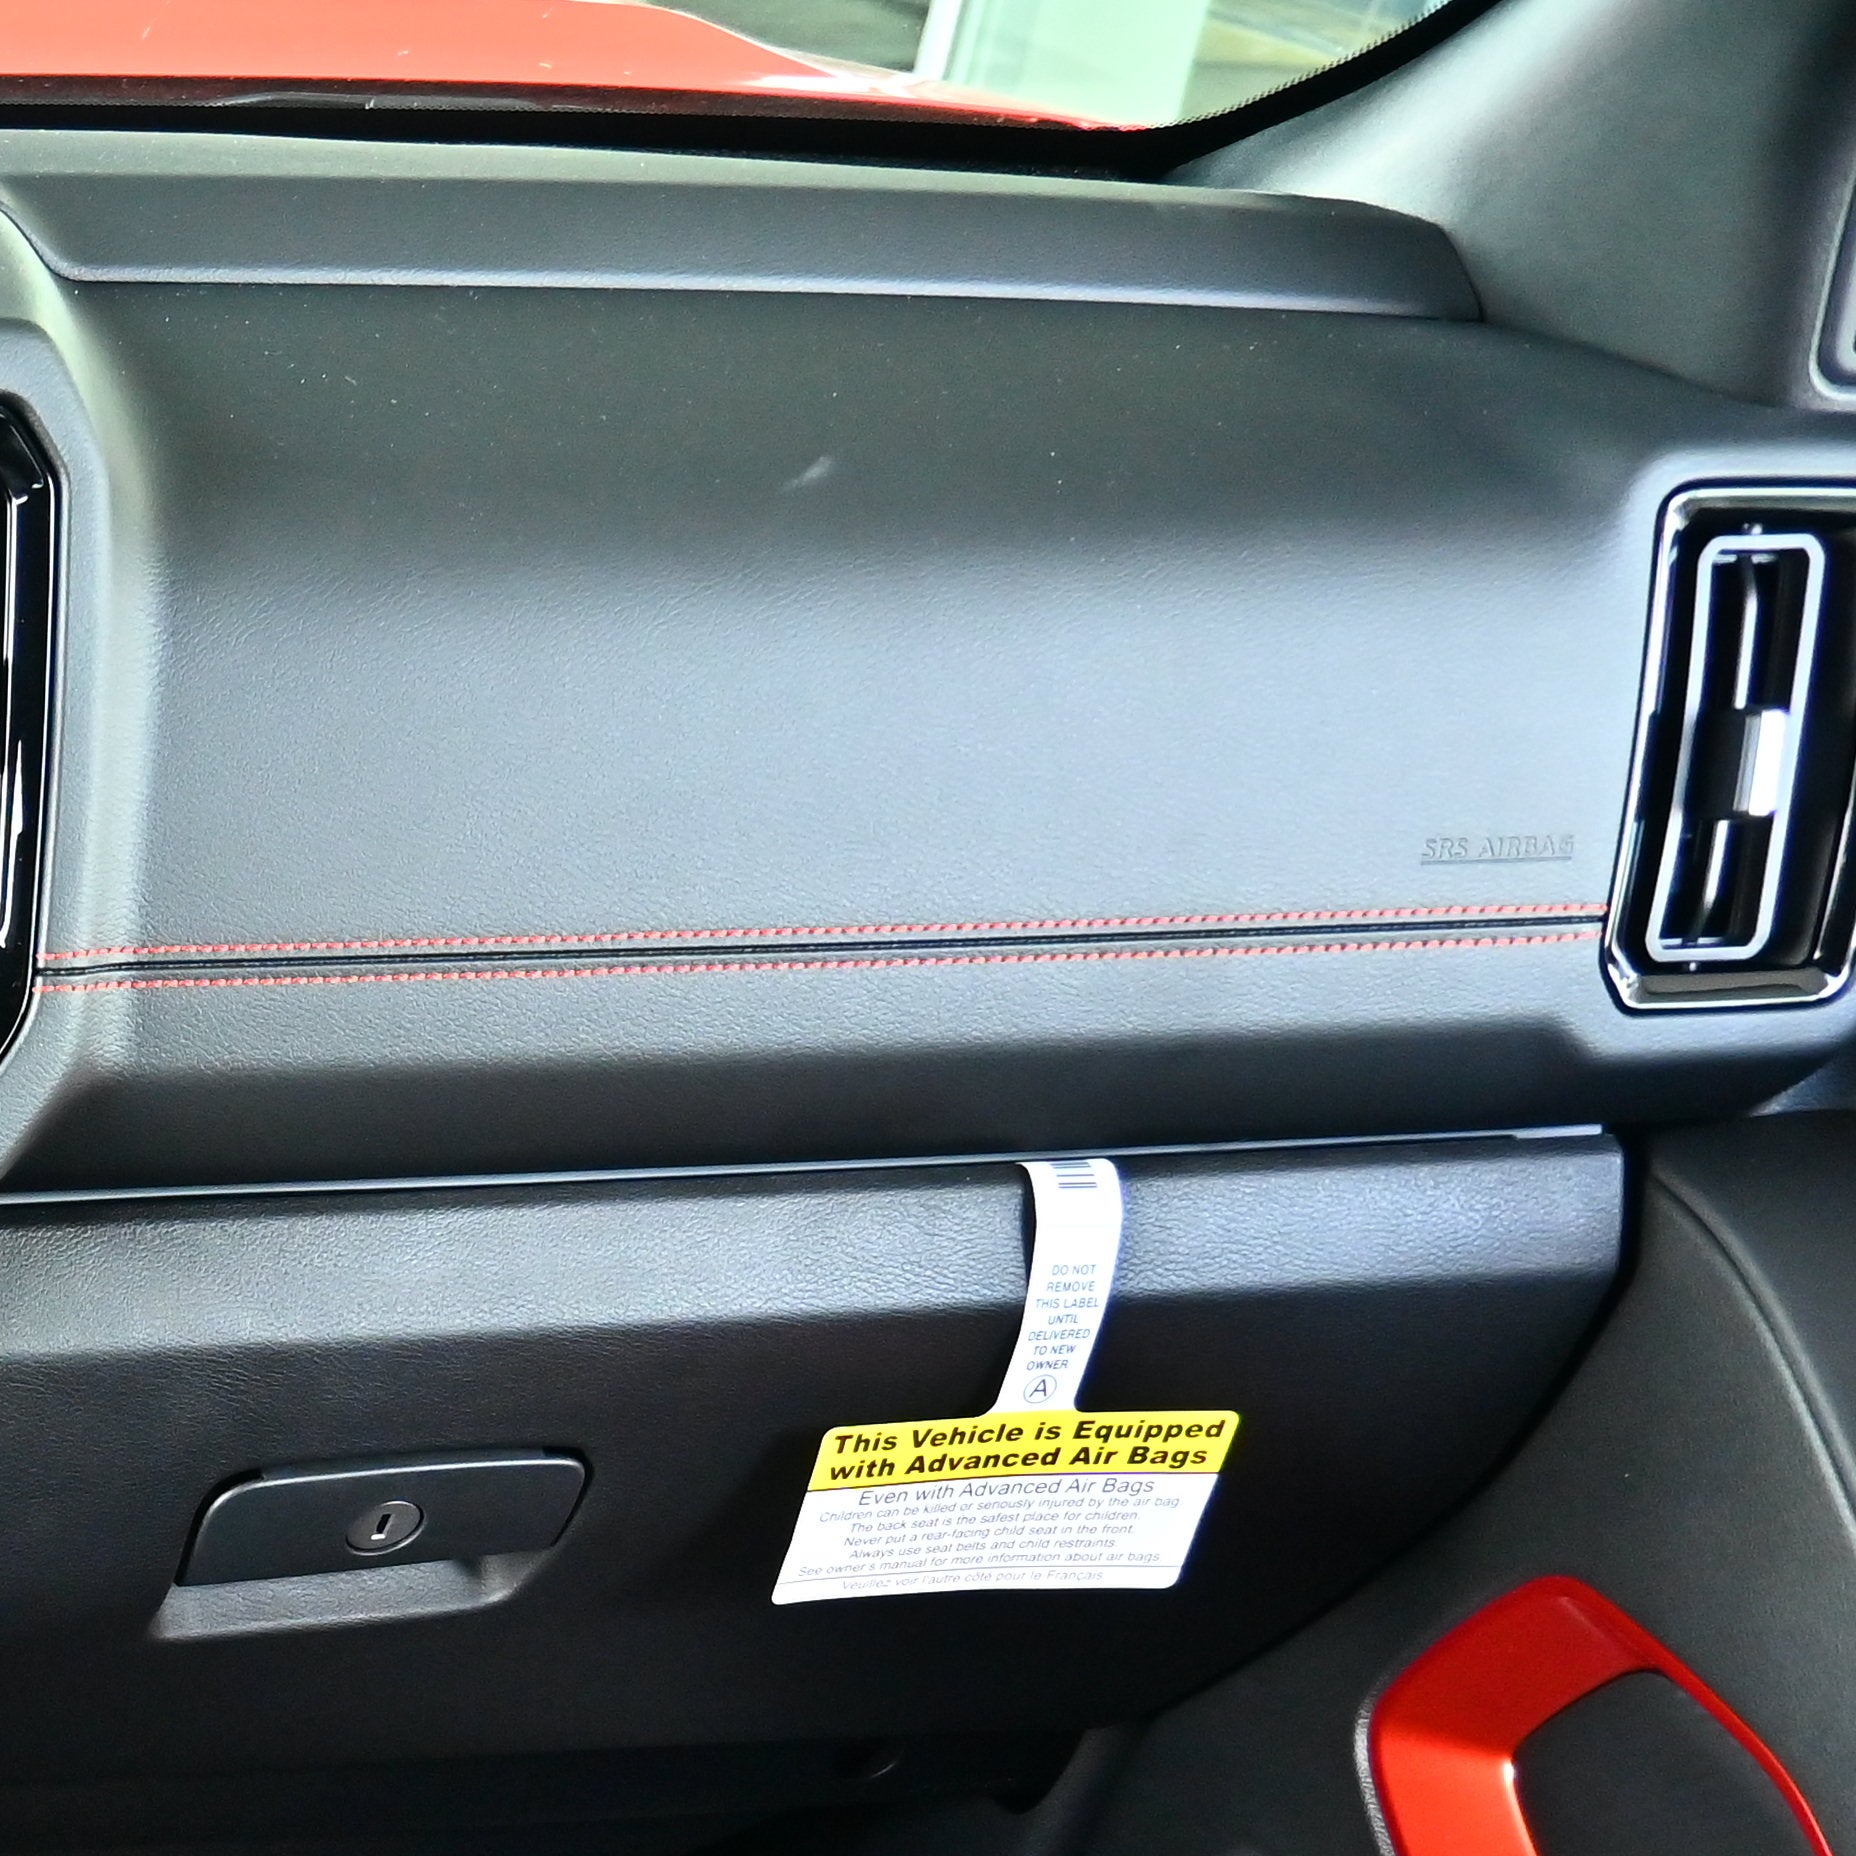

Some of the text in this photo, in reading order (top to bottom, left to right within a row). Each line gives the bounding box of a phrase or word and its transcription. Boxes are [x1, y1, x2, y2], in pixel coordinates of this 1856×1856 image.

[1051, 1264, 1096, 1276] DO NOT
[1046, 1281, 1096, 1292] REMOVE
[1036, 1297, 1099, 1309] THIS LABEL
[1048, 1315, 1079, 1325] UNTIL
[1028, 1329, 1091, 1341] DELIVERED
[1026, 1359, 1069, 1371] OWNER
[834, 1420, 1226, 1455] This Vehicle is Equipped
[829, 1446, 1208, 1481] with Advanced Air Bags
[858, 1477, 1155, 1506] Even with Advanced Air Bags
